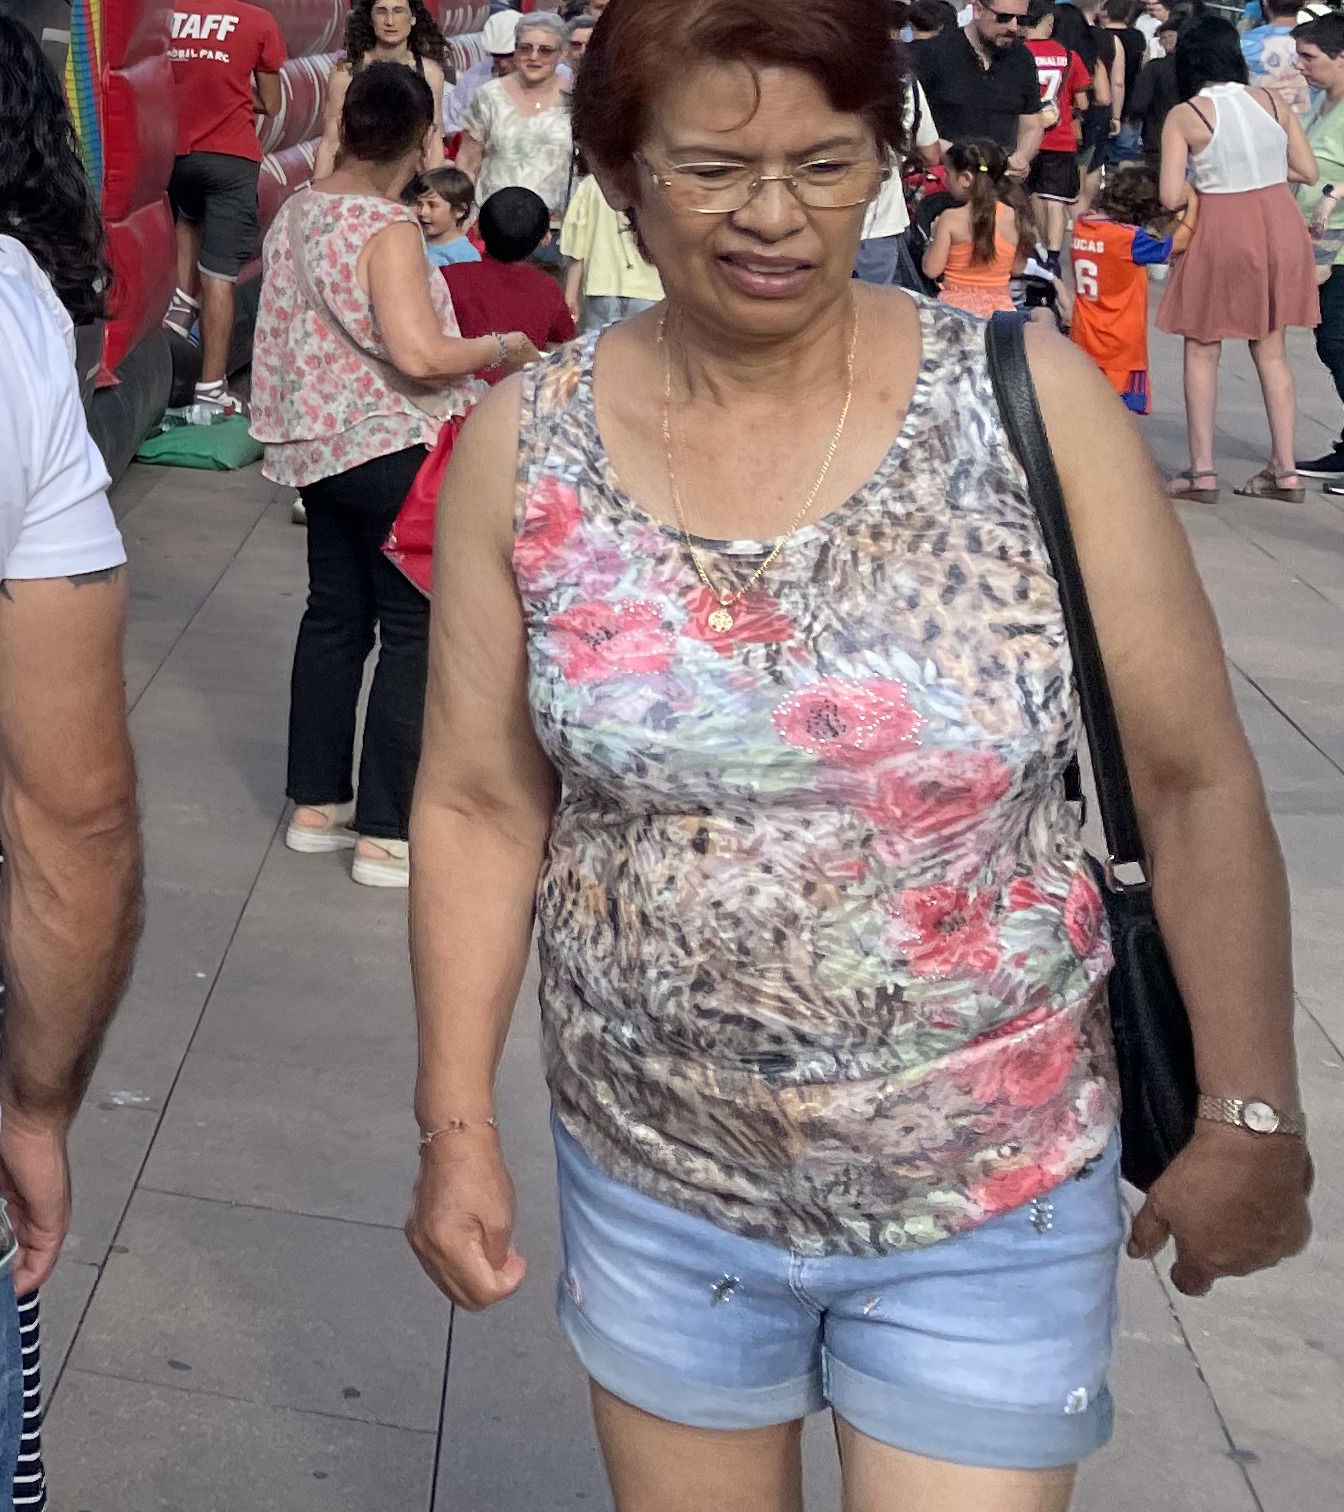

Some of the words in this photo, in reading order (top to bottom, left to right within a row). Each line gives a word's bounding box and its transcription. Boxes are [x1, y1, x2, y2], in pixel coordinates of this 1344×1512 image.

[171, 12, 240, 41] TAFF
[1037, 69, 1062, 102] 7
[1072, 238, 1105, 254] UCAS
[1074, 258, 1099, 302] 6
